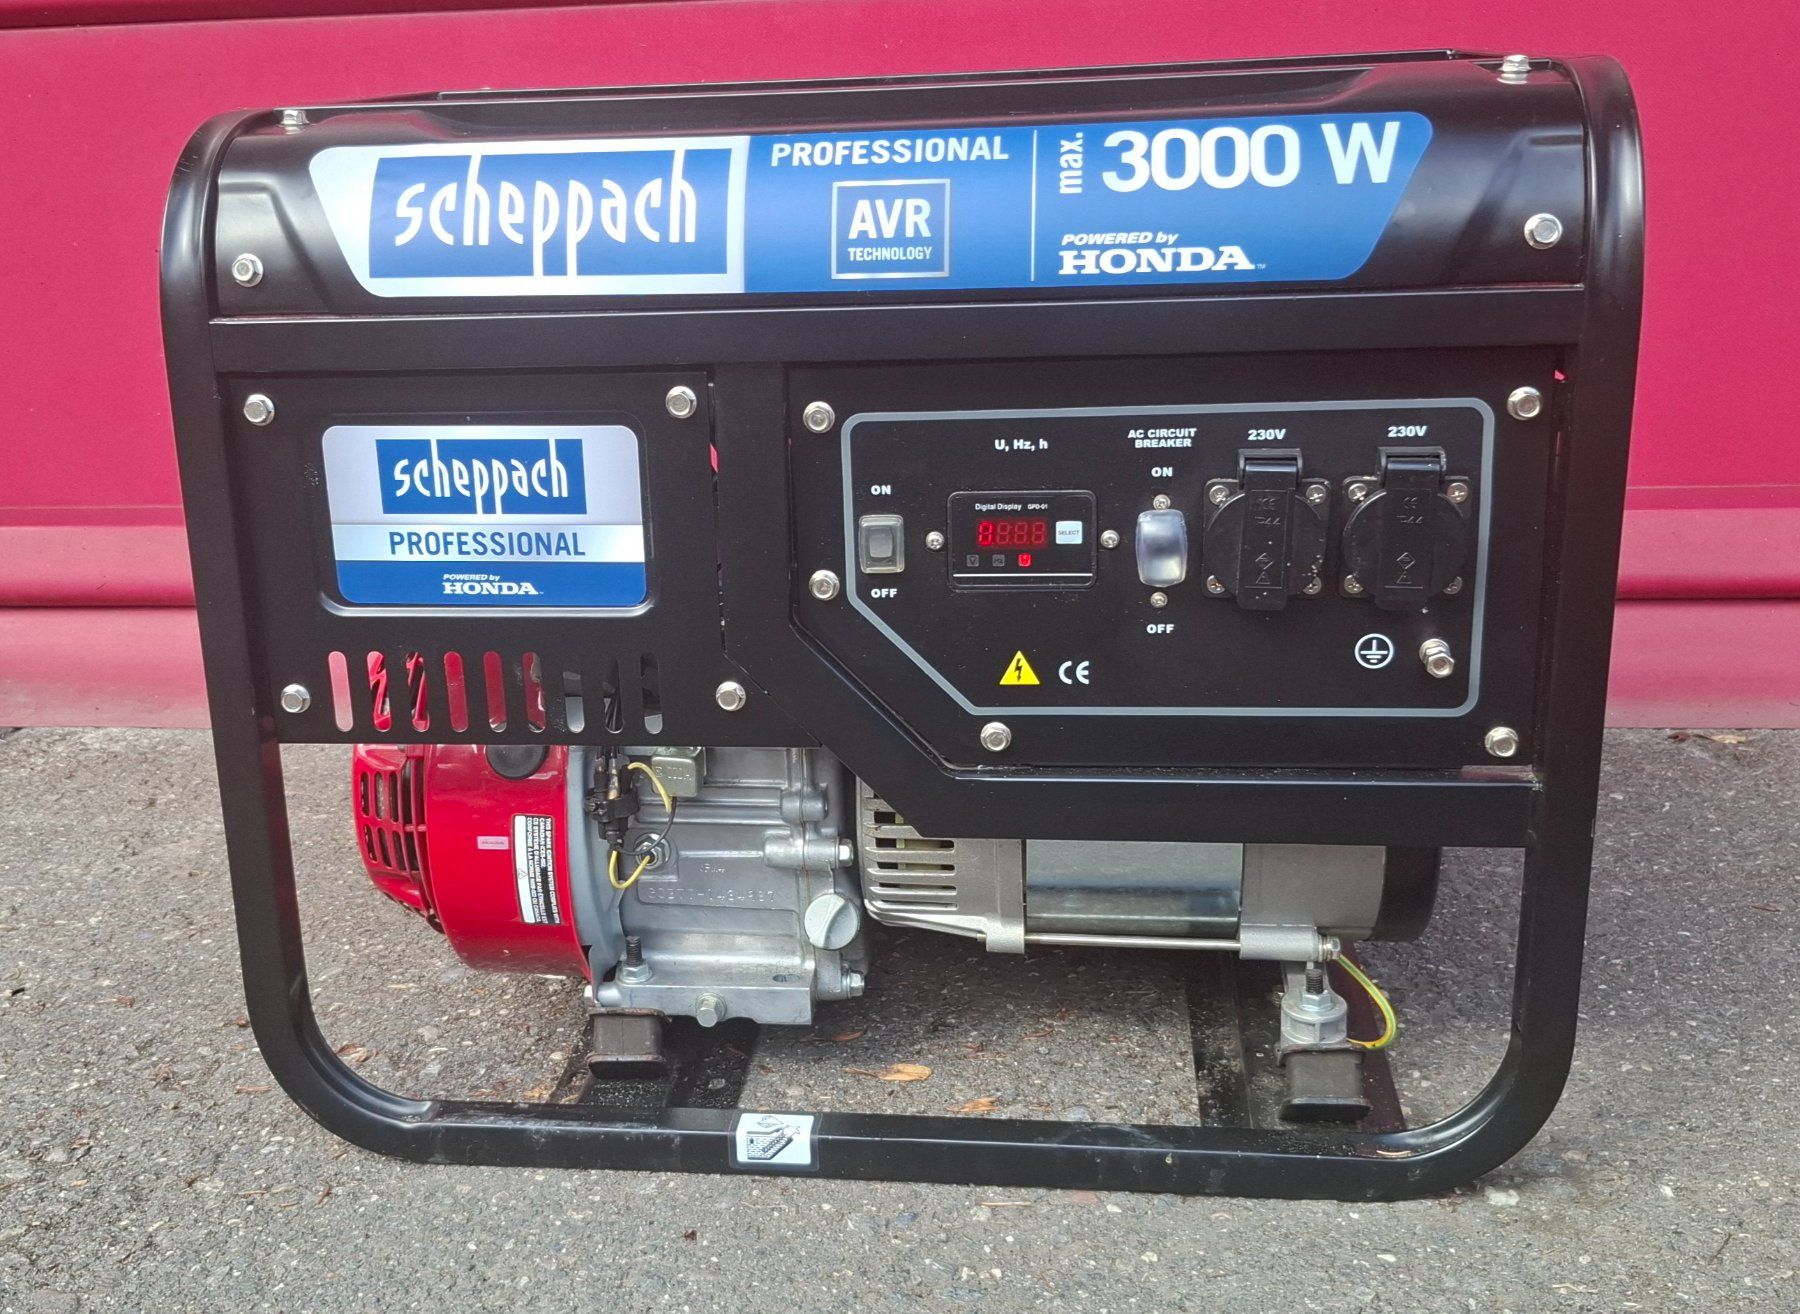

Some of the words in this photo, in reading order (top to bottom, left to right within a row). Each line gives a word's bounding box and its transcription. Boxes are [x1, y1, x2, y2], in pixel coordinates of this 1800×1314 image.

[771, 136, 1009, 167] PROFESSIONAL
[1102, 124, 1301, 192] 3000
[1321, 121, 1400, 184] W
[1058, 132, 1083, 194] max.
[395, 150, 696, 276] scheppach
[848, 198, 932, 239] AVR
[1061, 233, 1152, 246] POWERED
[1155, 232, 1178, 245] by
[848, 246, 932, 262] TECHNOLOGY
[1058, 245, 1255, 275] HONDA
[1128, 429, 1145, 438] AC
[1148, 428, 1197, 438] CIRCUIT
[1248, 429, 1286, 440] 230V
[1388, 425, 1427, 437] 230V
[995, 439, 1009, 451] U,
[1013, 439, 1037, 451] Hz,
[1039, 439, 1048, 450] h
[1135, 438, 1192, 448] BREAKER
[394, 439, 568, 514] scheppach
[1151, 467, 1173, 477] ON
[871, 485, 891, 495] ON
[975, 503, 996, 511] Digital
[997, 503, 1022, 511] Display
[389, 531, 586, 556] PROFESSIONAL
[443, 573, 488, 581] POWERED
[489, 574, 500, 582] by
[443, 582, 539, 595] HONDA
[871, 588, 897, 598] OFF
[1146, 624, 1174, 634] OFF
[1058, 660, 1090, 685] CE
